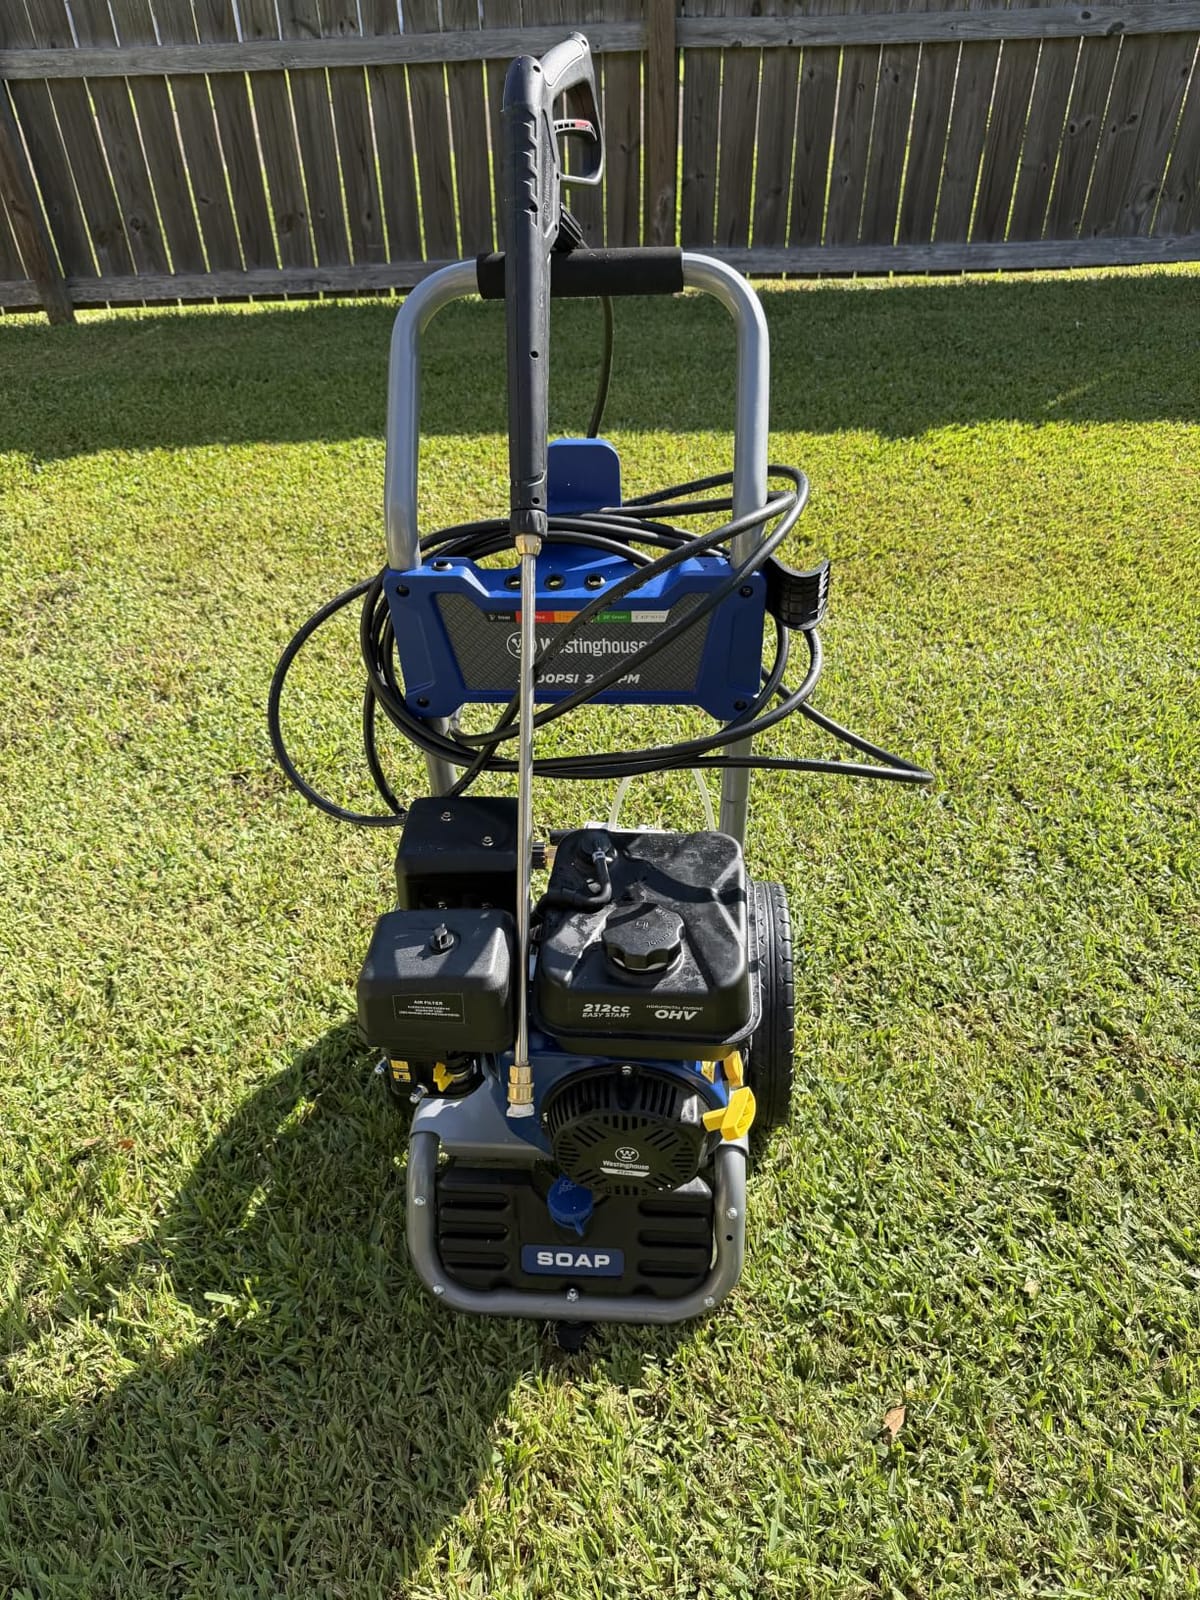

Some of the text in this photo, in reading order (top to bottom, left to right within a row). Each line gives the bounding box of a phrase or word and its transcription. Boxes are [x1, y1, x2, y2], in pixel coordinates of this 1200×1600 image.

[540, 637, 648, 657] Wstinghouse
[583, 1003, 631, 1013] 212cc
[654, 1009, 697, 1021] OHV
[602, 1160, 650, 1170] Westinghouse
[536, 1251, 610, 1269] SOAP
